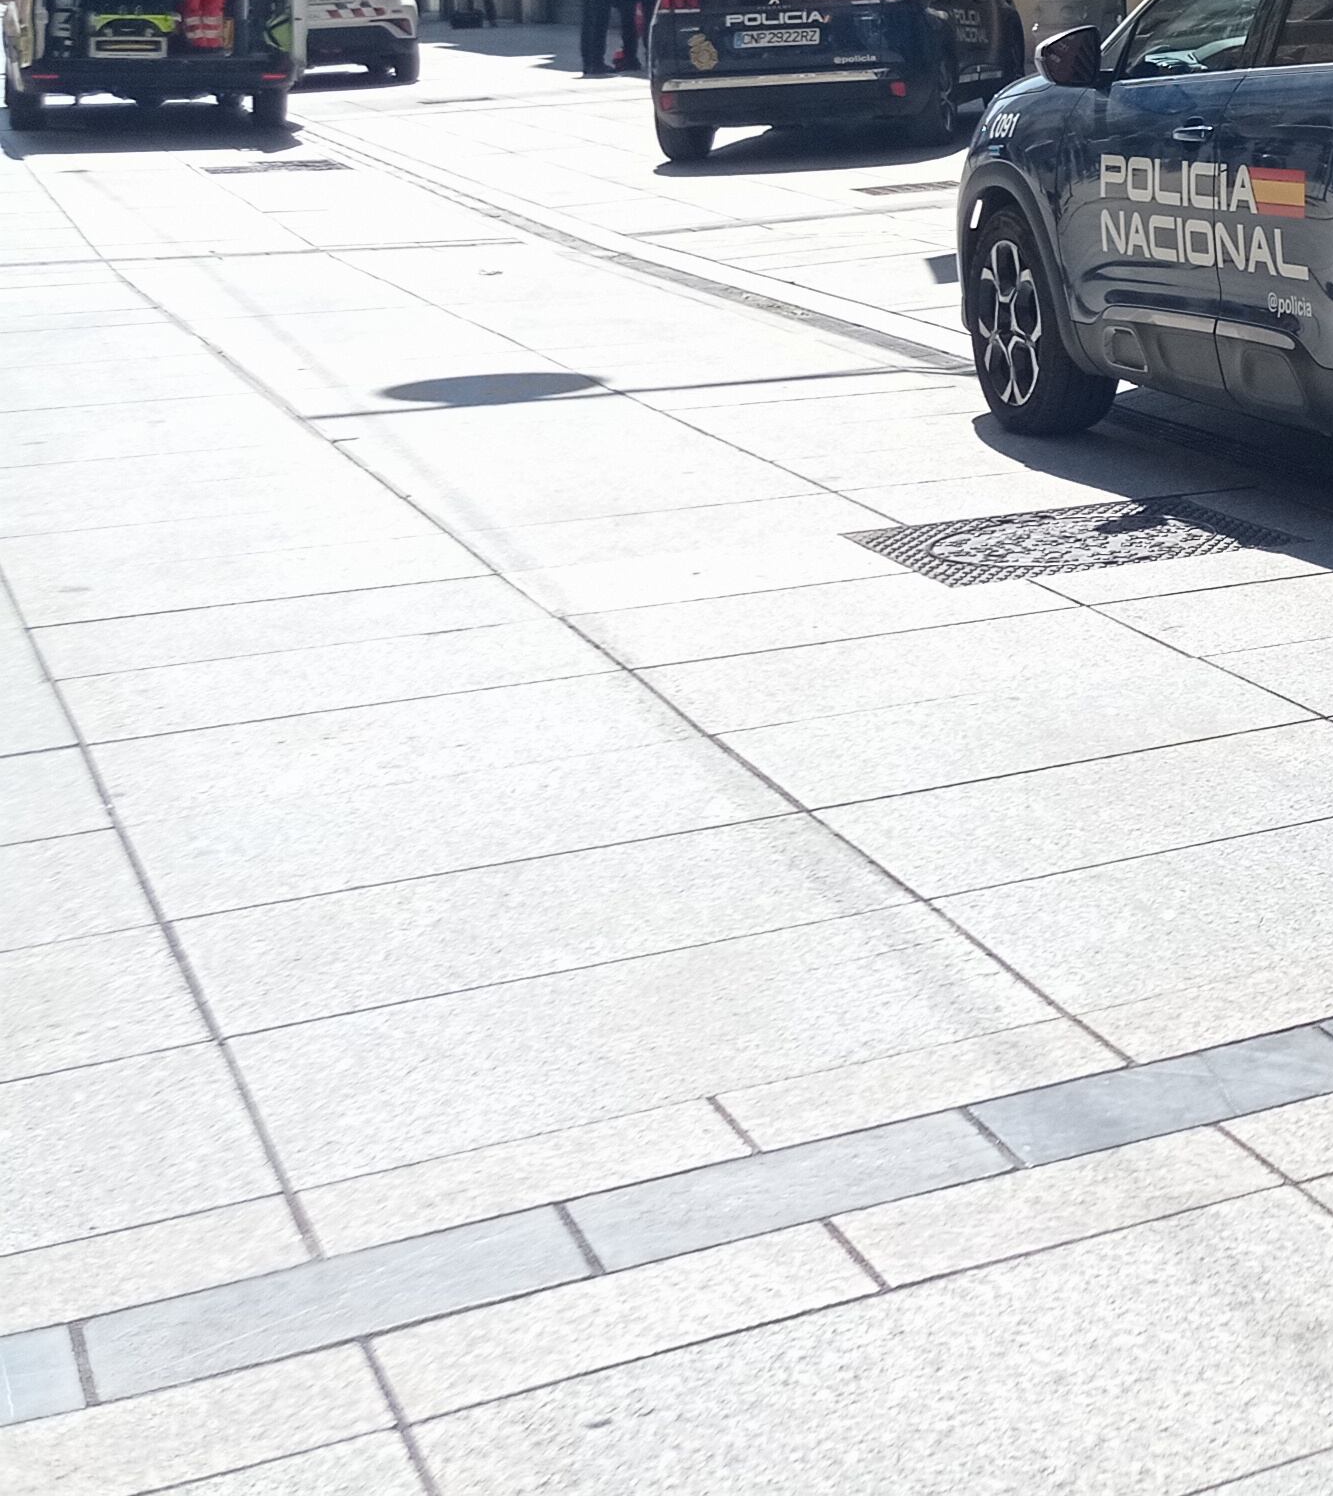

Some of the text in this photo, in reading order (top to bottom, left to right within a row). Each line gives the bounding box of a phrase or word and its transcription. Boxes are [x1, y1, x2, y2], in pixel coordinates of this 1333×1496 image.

[743, 29, 818, 47] CNP2922RZ
[833, 54, 877, 64] @policia
[998, 112, 1019, 139] 091
[1099, 207, 1311, 281] NACIONAL
[1267, 290, 1313, 318] @policia
